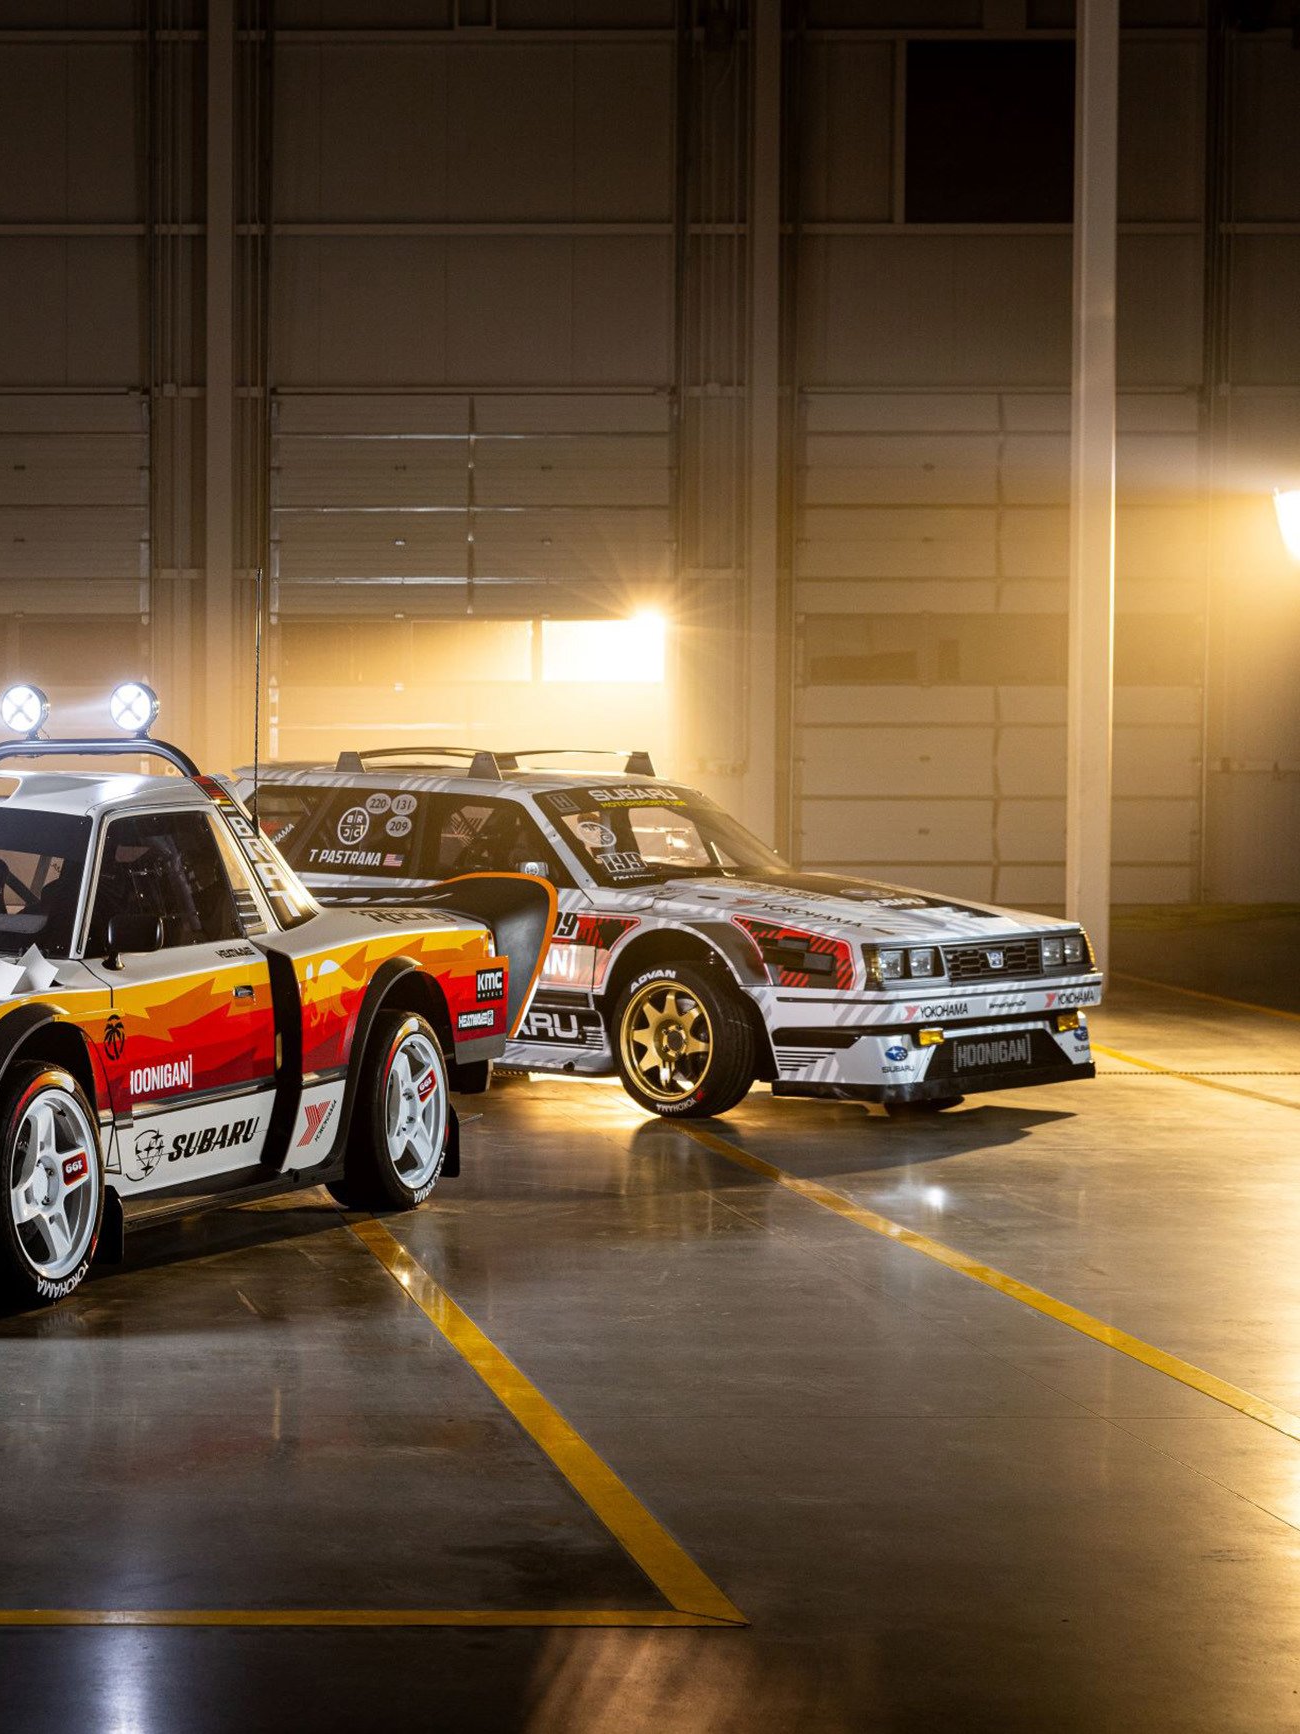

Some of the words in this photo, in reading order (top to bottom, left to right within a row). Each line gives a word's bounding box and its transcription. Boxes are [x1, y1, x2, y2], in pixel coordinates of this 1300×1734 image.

[588, 789, 679, 801] SUBARU
[370, 799, 386, 809] 220
[396, 800, 412, 810] 131
[390, 821, 408, 832] 209
[318, 850, 382, 866] PASTRANA
[761, 903, 863, 927] YOKOHAMA
[630, 969, 677, 993] ADVAN
[1057, 991, 1095, 1005] YOKOHAMA
[920, 1002, 969, 1019] YOKOHAMA
[952, 1033, 1032, 1073] [HOONIGAN]
[881, 1064, 915, 1074] SUBARU
[167, 1116, 260, 1163] SUBARU
[37, 1260, 90, 1298] YOKOHAMA
